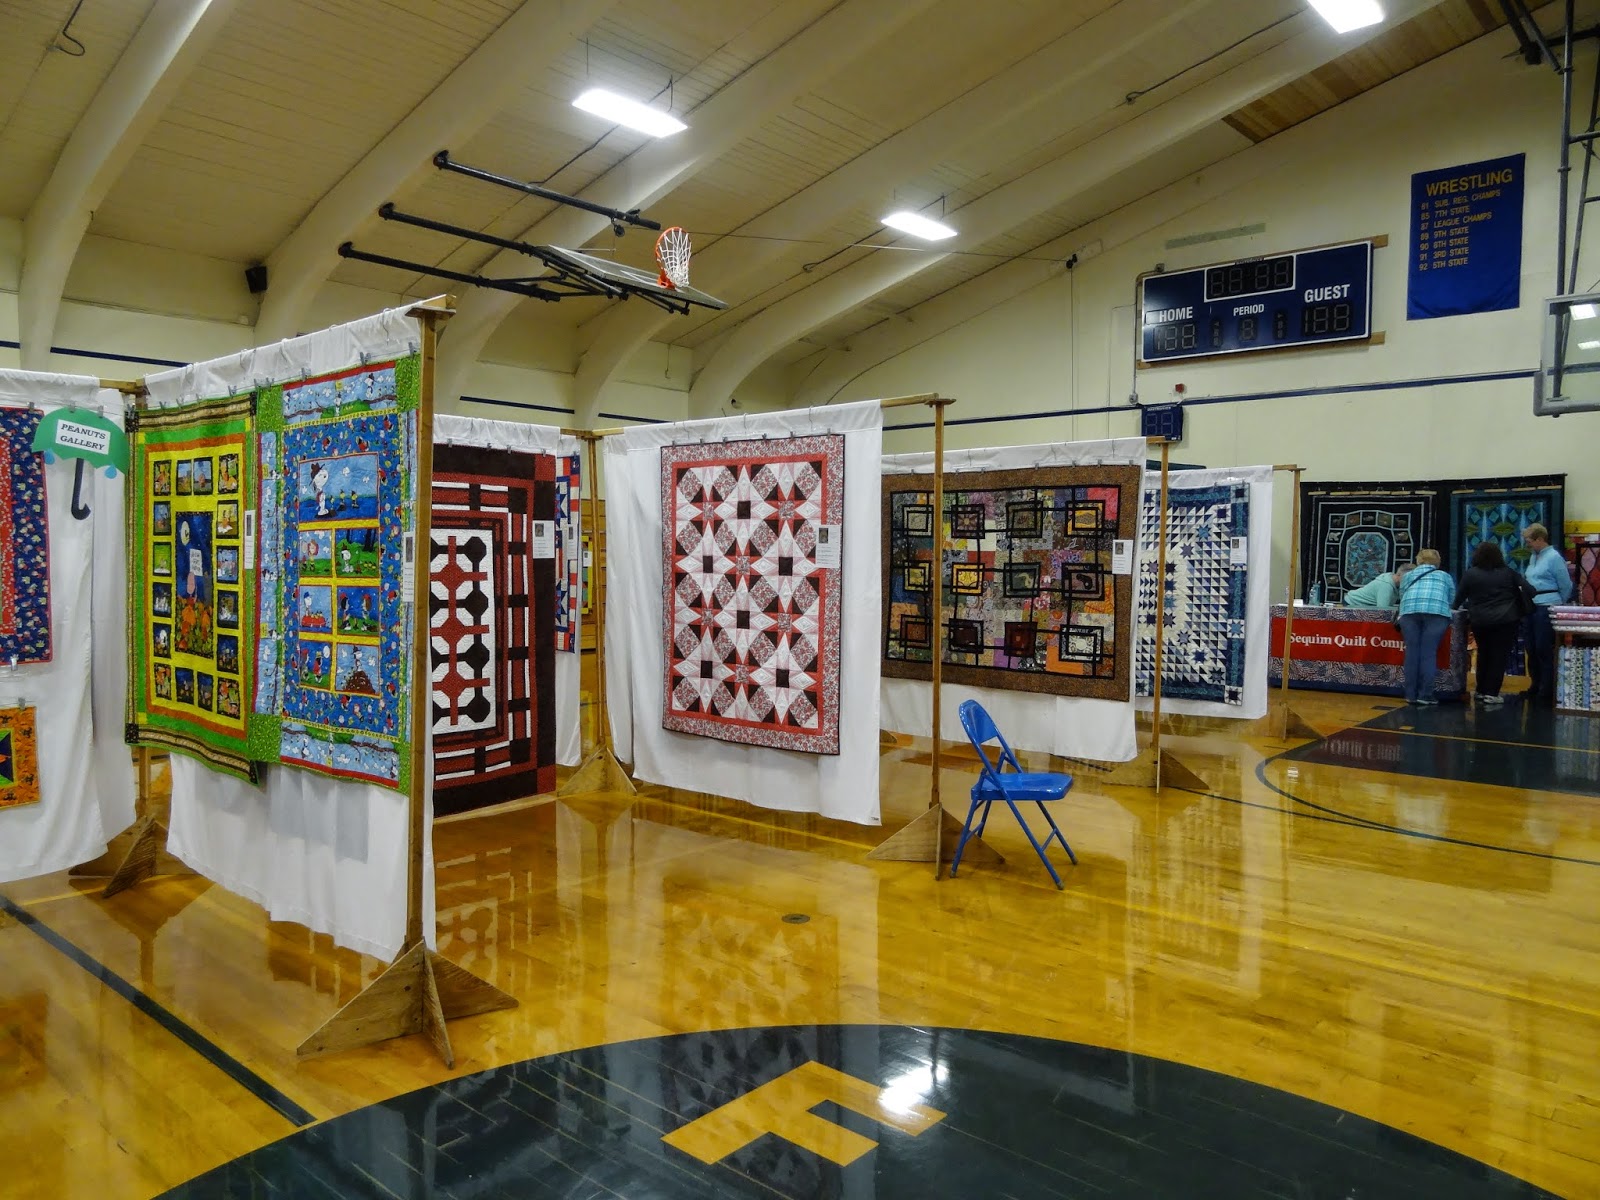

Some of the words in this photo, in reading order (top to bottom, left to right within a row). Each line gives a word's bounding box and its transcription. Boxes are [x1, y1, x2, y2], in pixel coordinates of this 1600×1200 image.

[1426, 169, 1512, 196] WRESTLING
[1472, 190, 1500, 200] CHAMPS
[1450, 206, 1470, 216] STATE
[1434, 218, 1460, 228] LEAGUE
[1462, 212, 1492, 224] CHAMPS
[1450, 226, 1468, 236] STATE
[1450, 236, 1468, 246] STATE
[1450, 246, 1468, 256] STATE
[1418, 262, 1428, 270] 92
[1448, 256, 1468, 266] STATE
[1304, 284, 1351, 303] GUEST
[1158, 306, 1194, 323] HOME
[1233, 303, 1265, 317] PERIOD
[60, 423, 107, 440] PEANUTS
[60, 435, 106, 451] GALLERY
[1290, 632, 1332, 647] Sequim
[1334, 634, 1367, 648] Quilt
